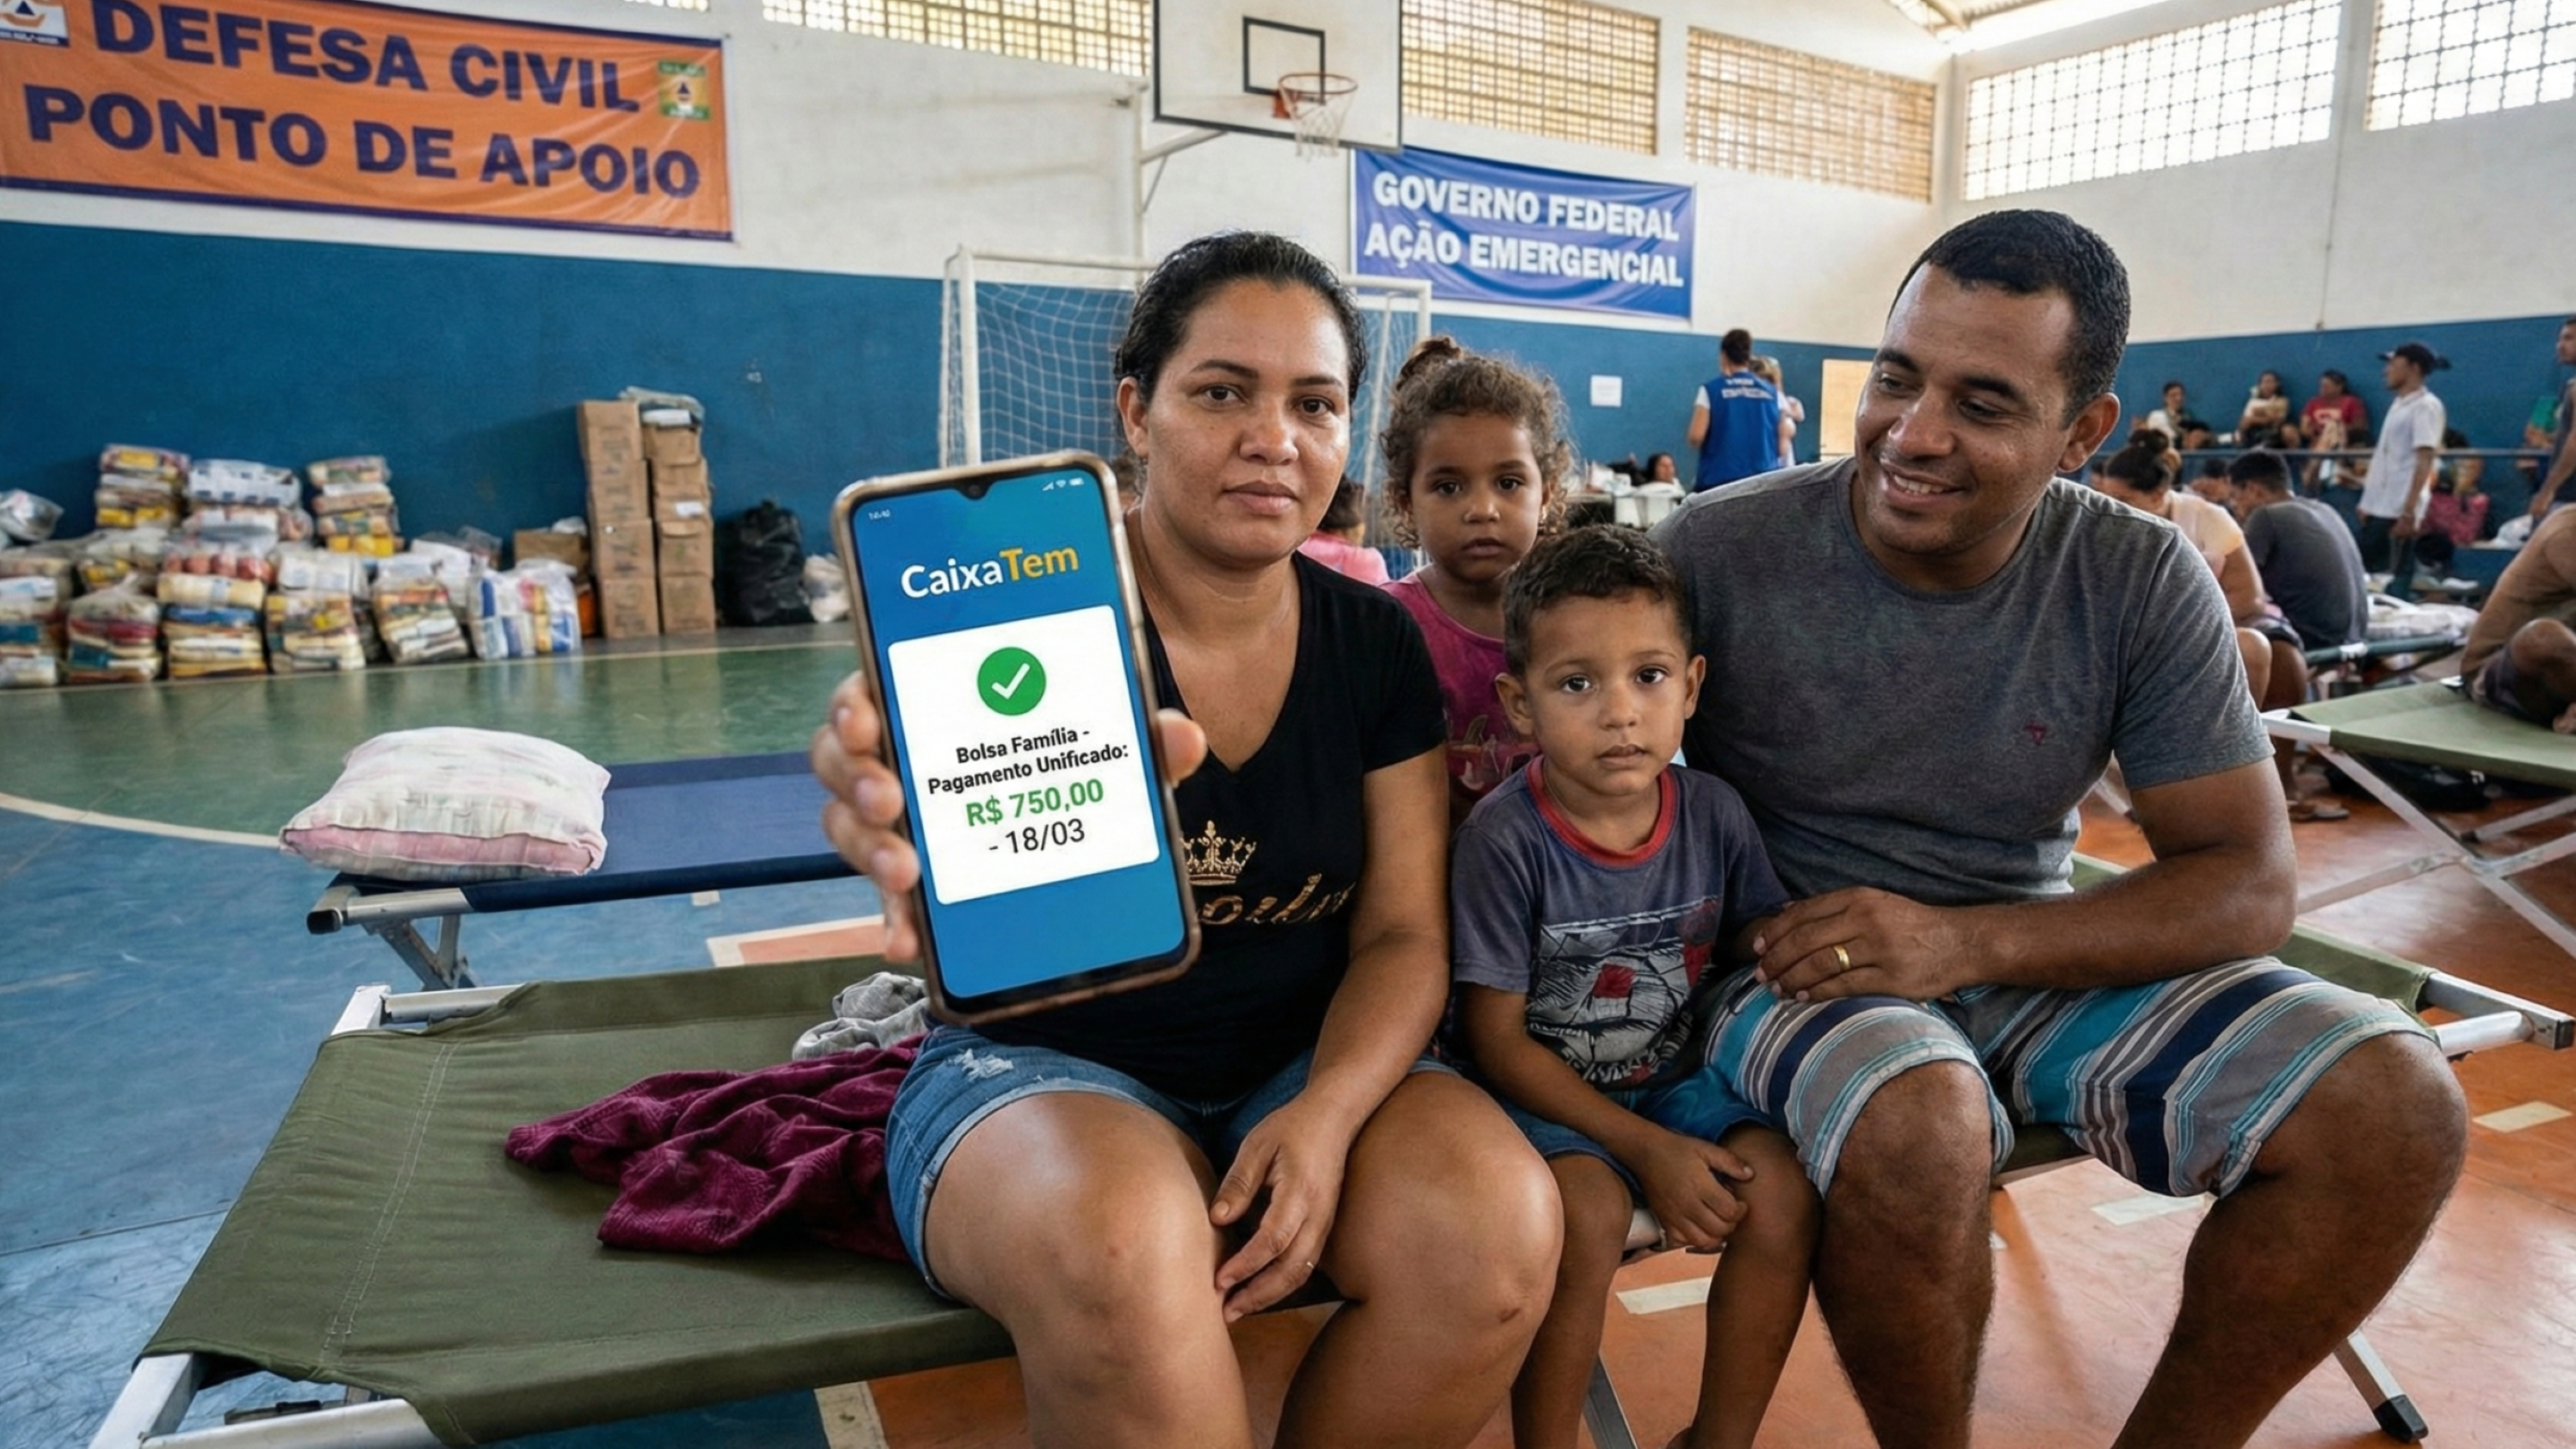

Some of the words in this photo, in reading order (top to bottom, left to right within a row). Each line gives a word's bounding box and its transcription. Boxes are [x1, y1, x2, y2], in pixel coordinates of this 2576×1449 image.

[93, 0, 428, 91] DEFESA
[449, 46, 640, 113] CIVIL
[24, 84, 327, 167] PONTO
[353, 122, 457, 179] DE
[479, 134, 700, 199] APOIO
[1373, 172, 1540, 224] GOVERNO
[1548, 195, 1679, 242] FEDERAL
[1364, 220, 1462, 268] AÇÃO
[1470, 234, 1683, 287] EMERGENCIAL
[928, 764, 1032, 794] Pagamento
[1037, 743, 1129, 774] Unificado:
[955, 742, 1008, 764] Bolsa
[1011, 726, 1079, 753] Família
[966, 795, 1004, 826] R$
[1009, 779, 1104, 818] 750,00
[1005, 818, 1085, 853] 18/03
